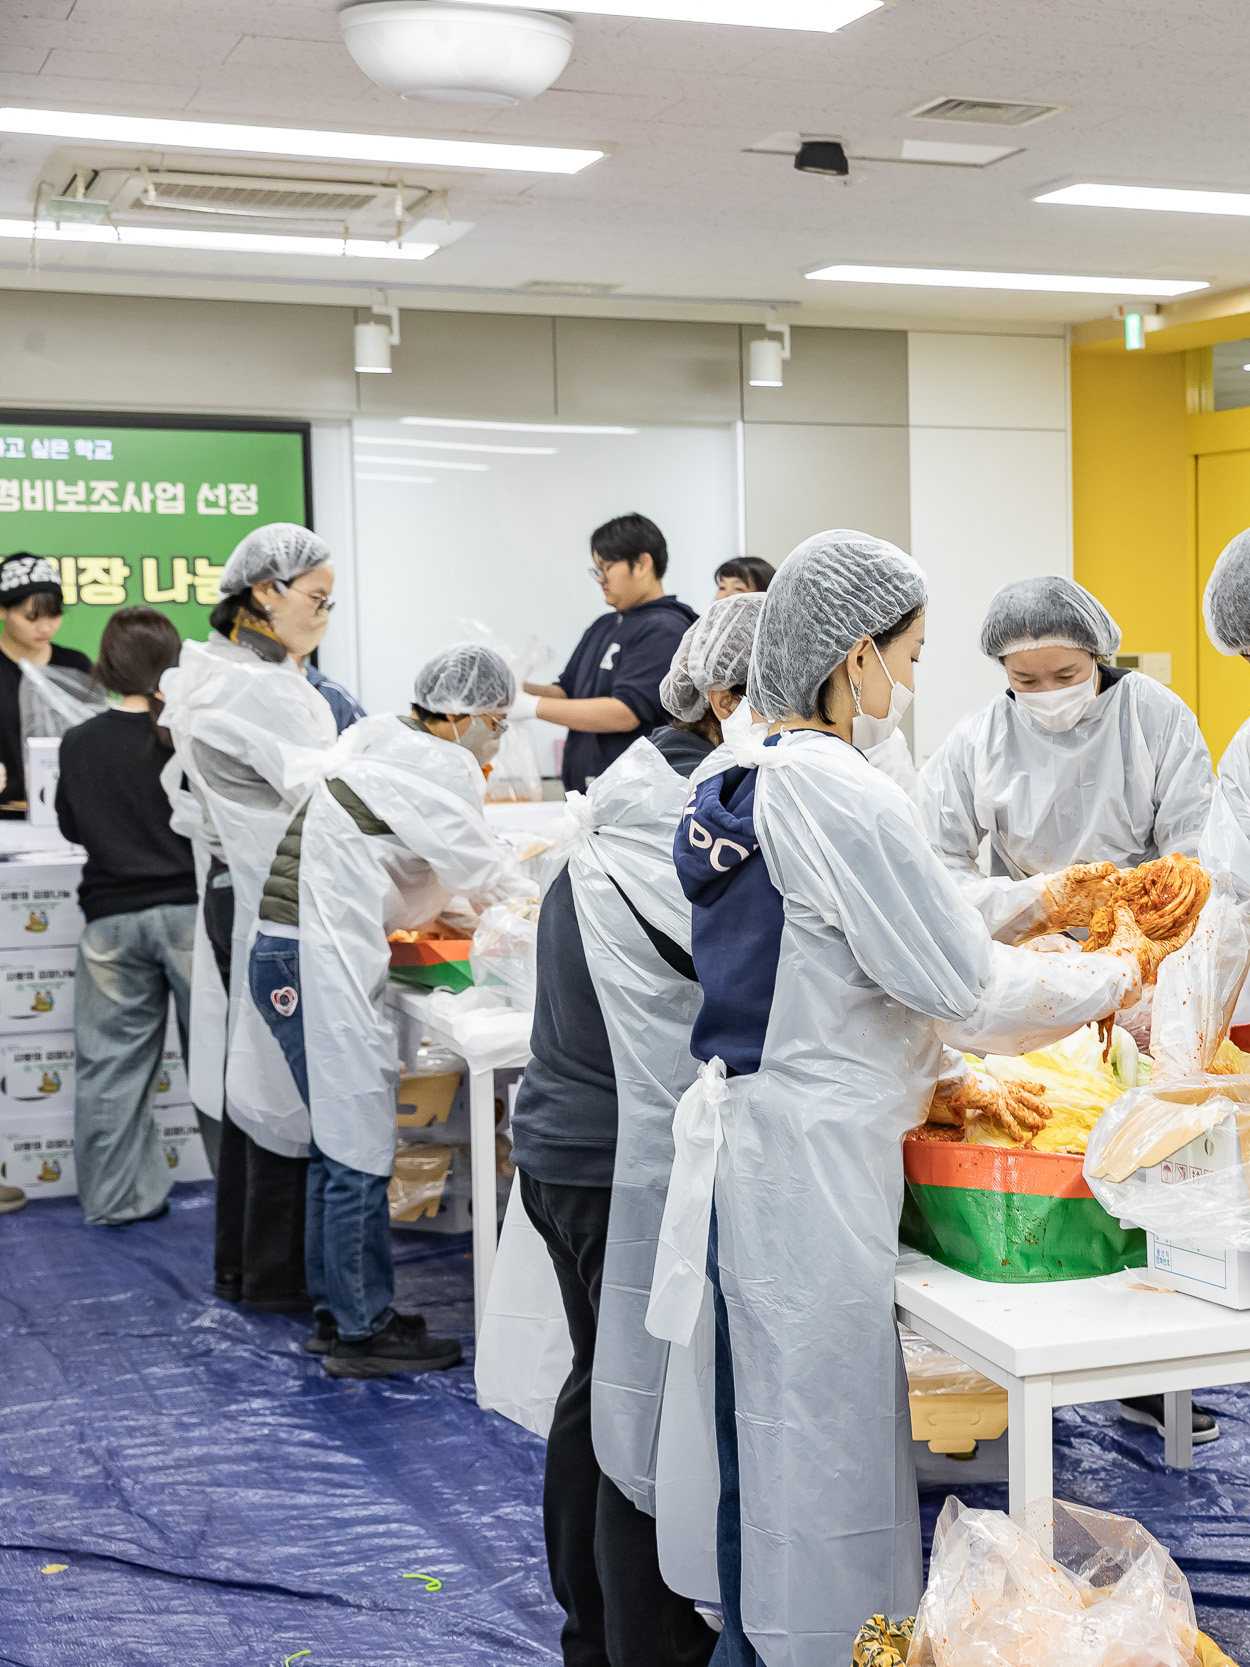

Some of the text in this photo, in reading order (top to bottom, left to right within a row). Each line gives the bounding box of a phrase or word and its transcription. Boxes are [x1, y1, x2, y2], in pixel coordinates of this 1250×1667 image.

[0, 436, 26, 459] 고
[74, 438, 114, 461] 학교
[197, 482, 259, 516] 선정
